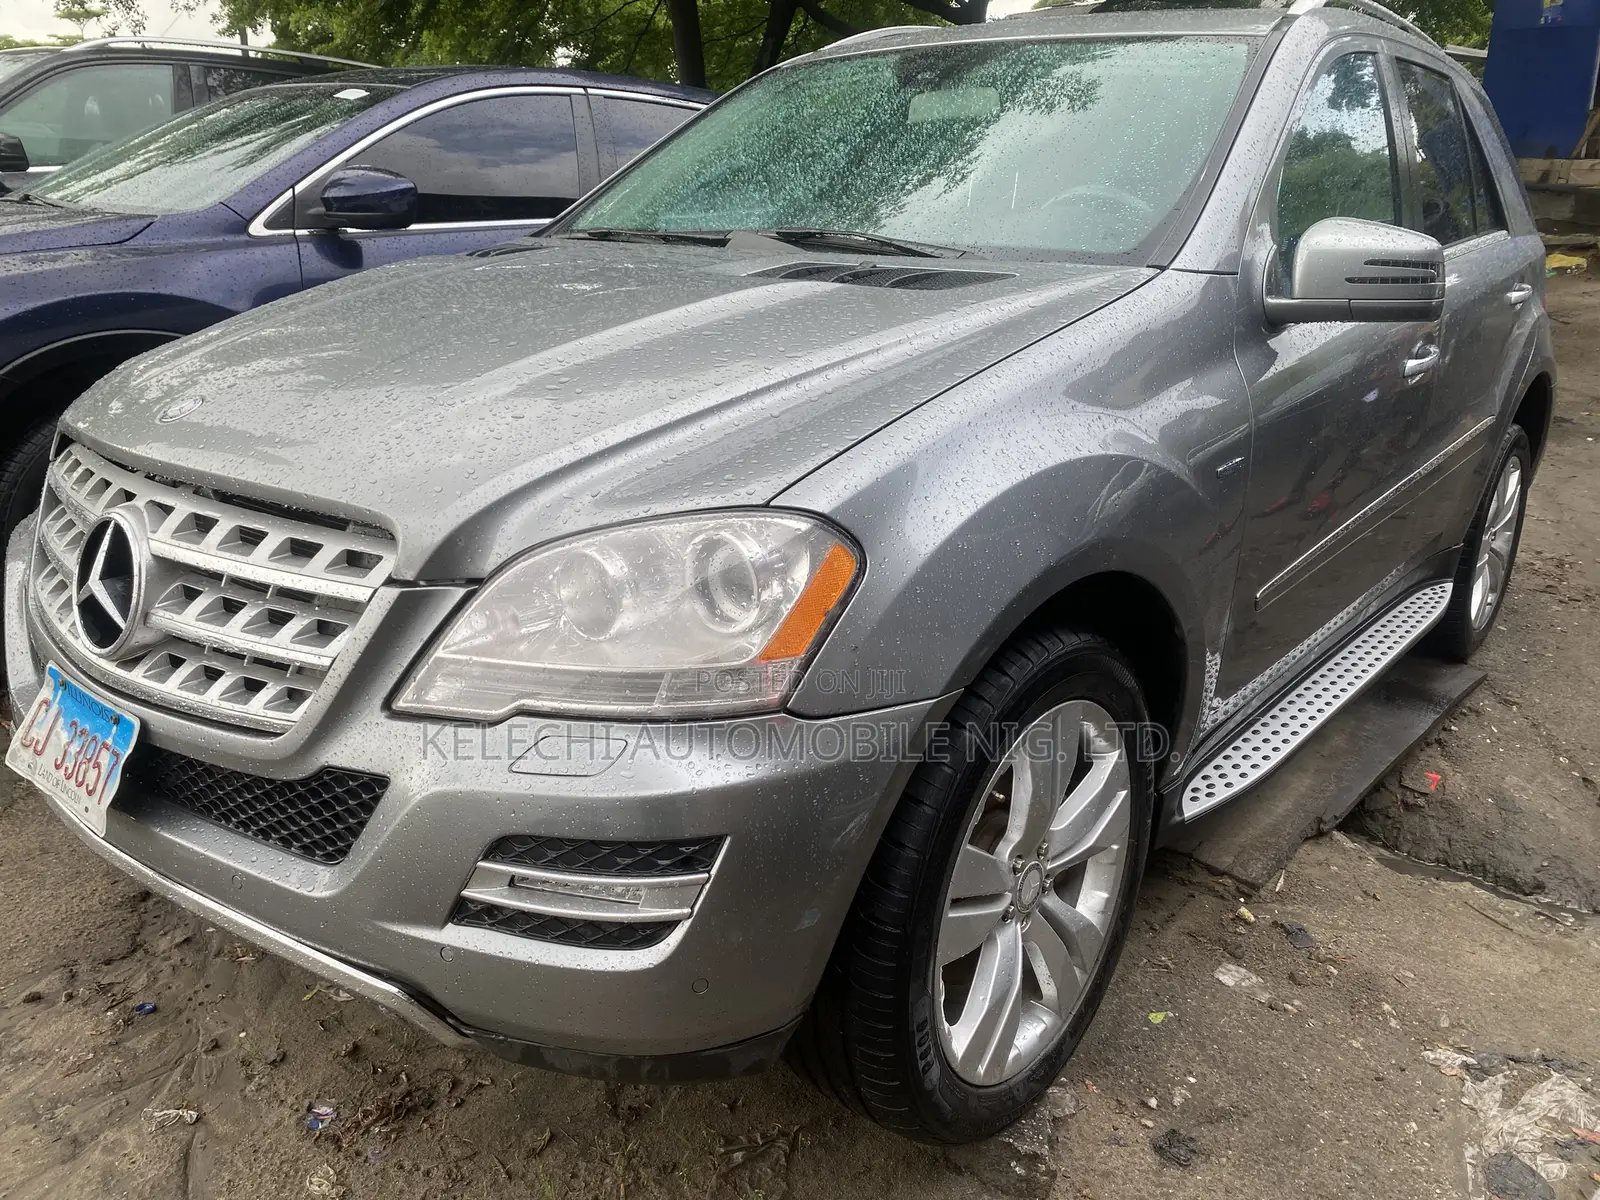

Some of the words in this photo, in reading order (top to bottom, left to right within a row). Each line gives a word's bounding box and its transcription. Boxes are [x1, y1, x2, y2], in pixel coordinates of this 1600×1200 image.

[65, 682, 111, 723] ILLINOIS
[21, 696, 62, 757] CJ
[54, 719, 122, 806] 33857
